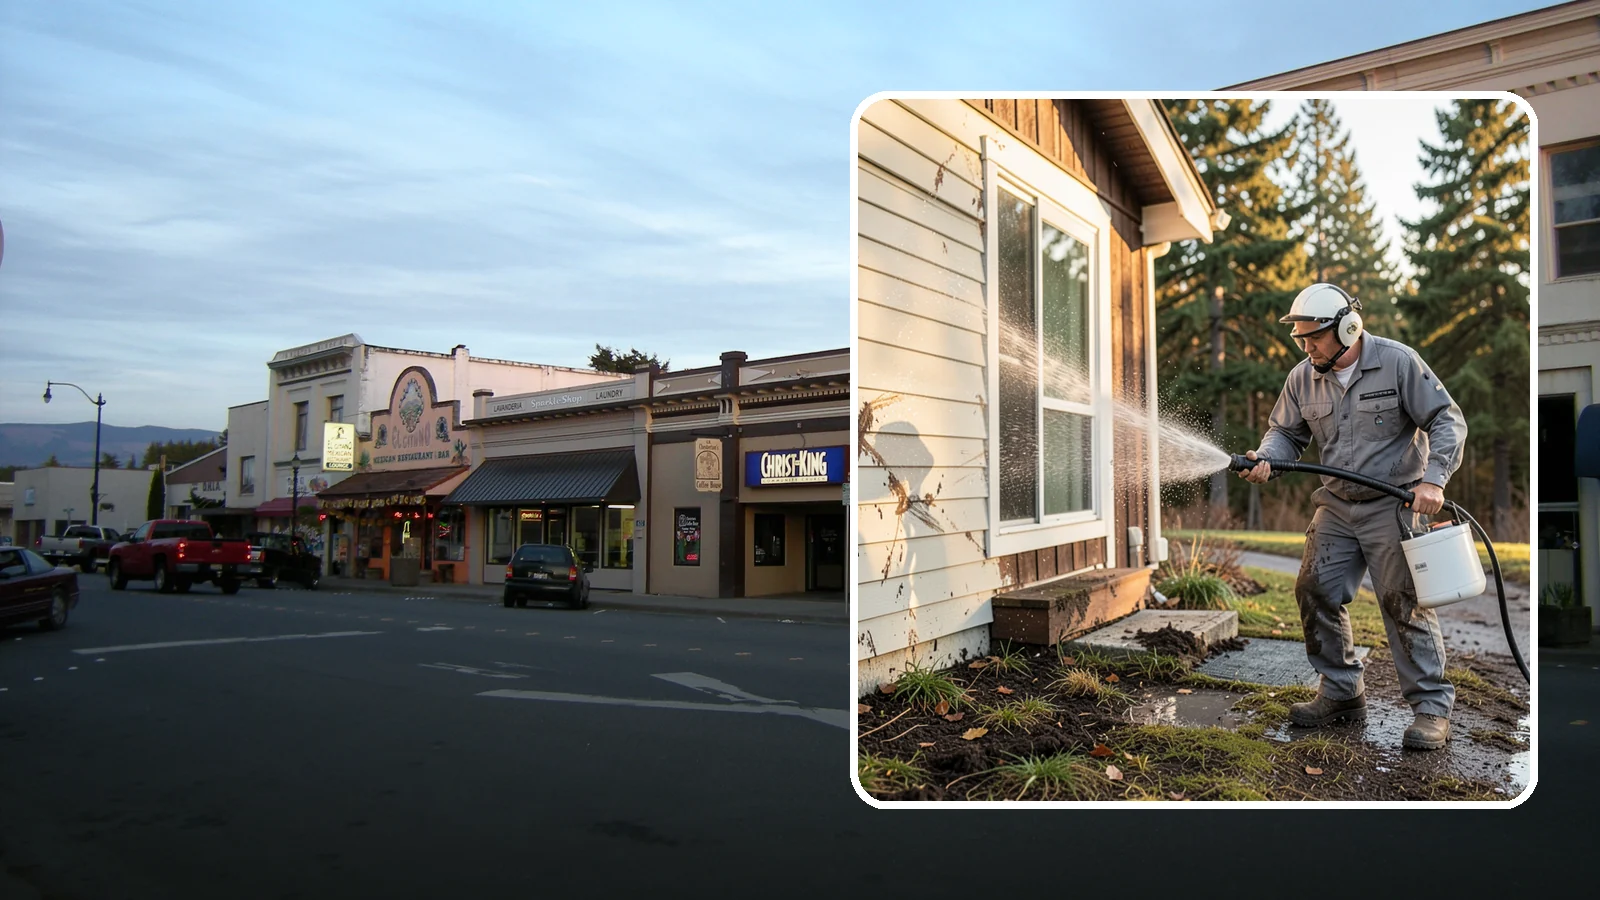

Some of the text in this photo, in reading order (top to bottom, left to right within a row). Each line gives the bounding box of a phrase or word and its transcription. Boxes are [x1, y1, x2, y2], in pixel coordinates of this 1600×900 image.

[595, 389, 624, 400] LAUNDRY
[530, 394, 583, 409] Sparkle Shop
[493, 402, 523, 413] LAVANDERIA
[397, 452, 433, 462] RESTAURANT
[438, 450, 450, 459] BAR
